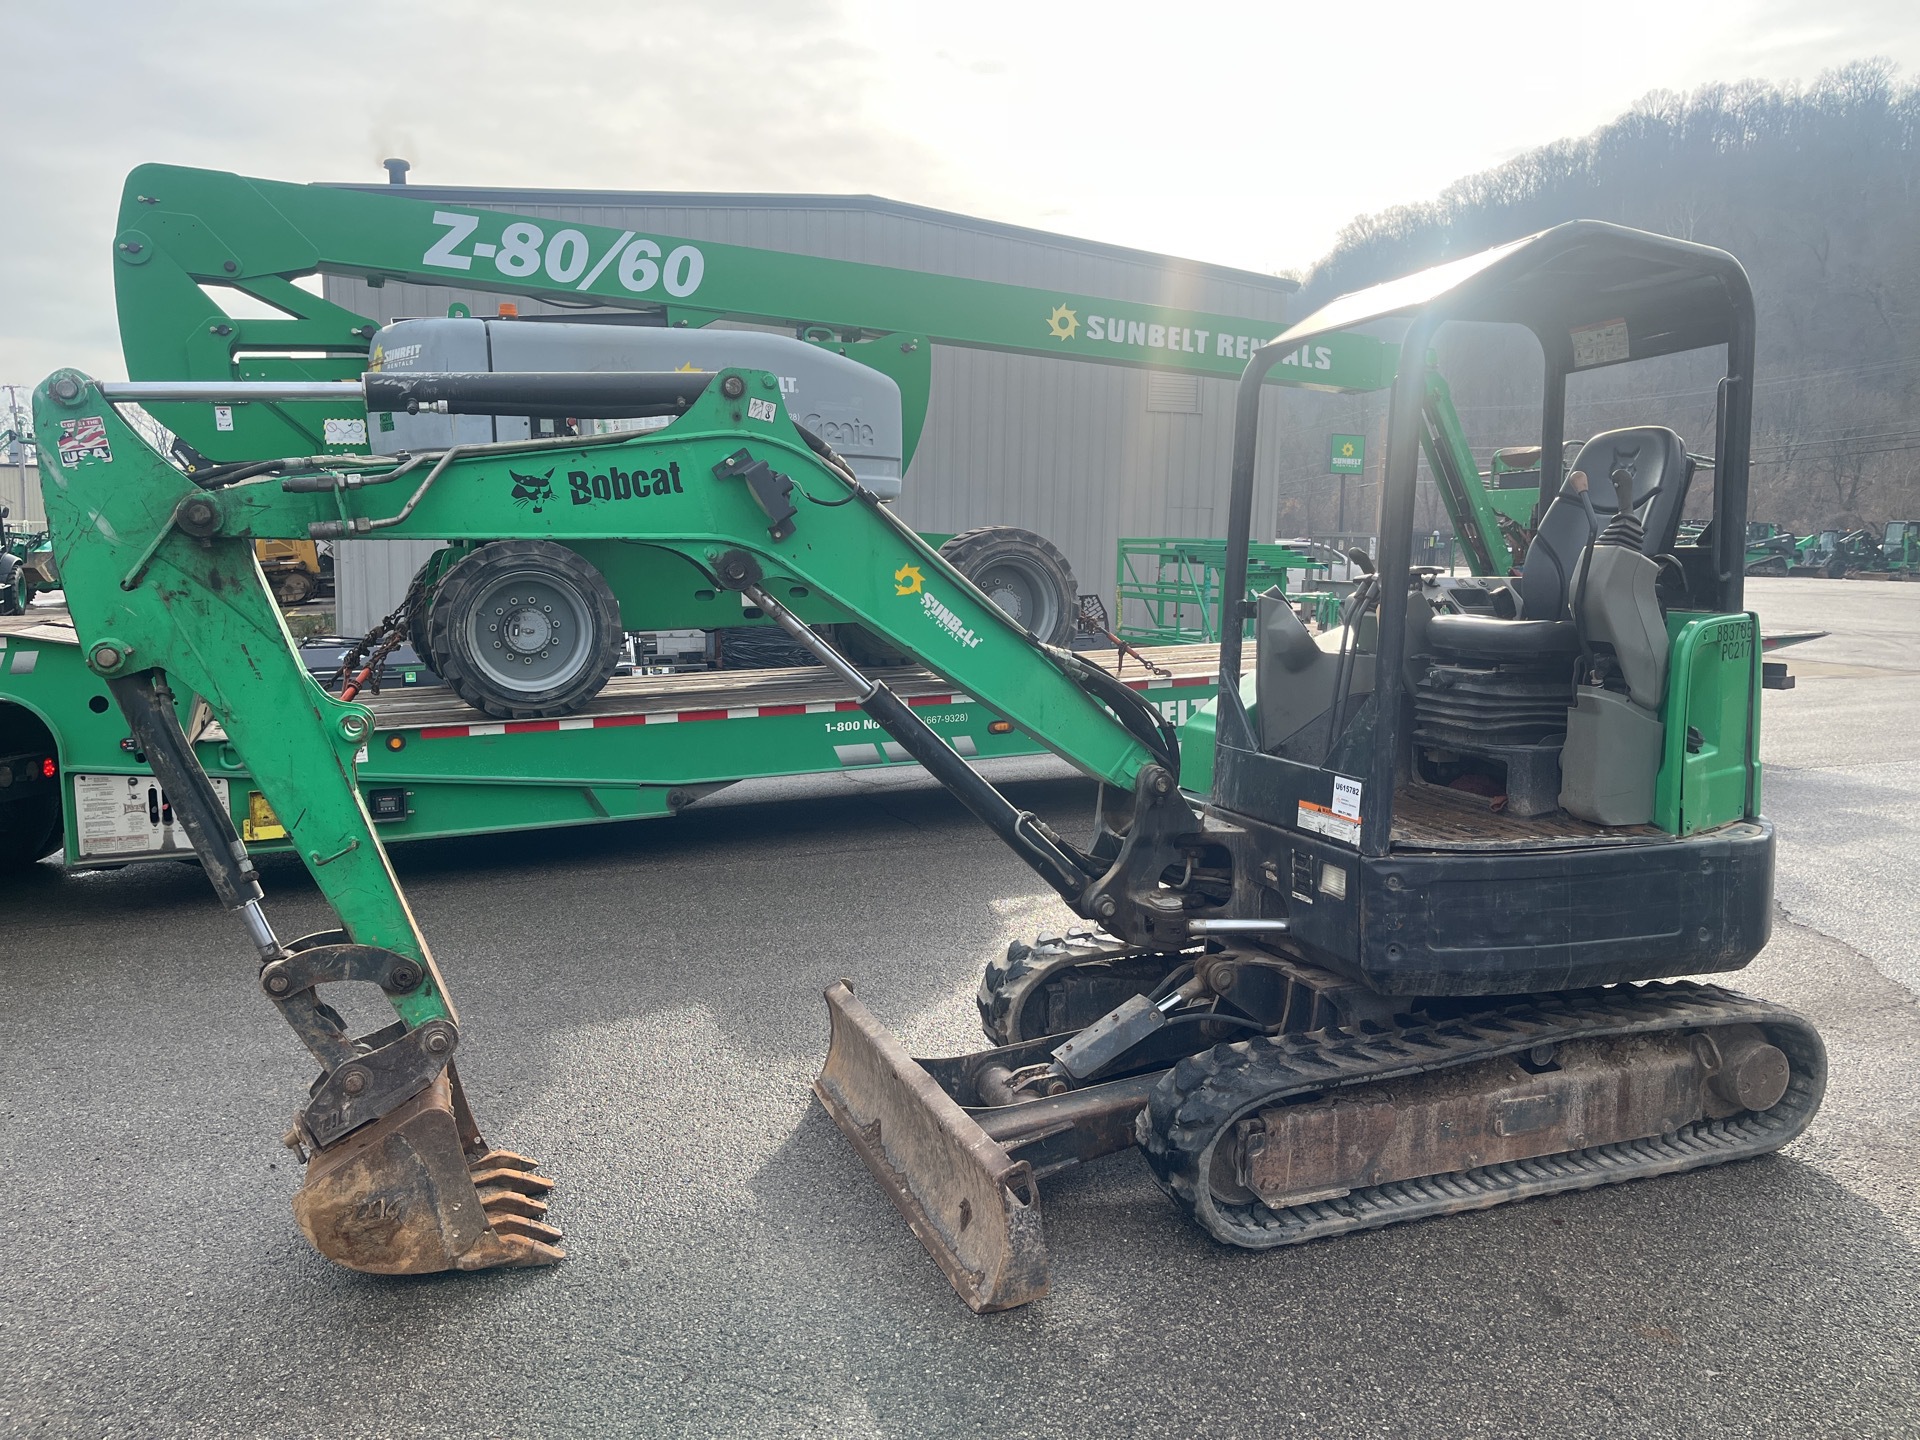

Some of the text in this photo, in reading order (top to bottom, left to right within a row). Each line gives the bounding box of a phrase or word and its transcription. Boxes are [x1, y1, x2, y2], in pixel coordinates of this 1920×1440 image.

[422, 210, 705, 298] Z-80/60
[1086, 315, 1332, 370] SUNBELT RENALS
[802, 413, 874, 447] Genie
[567, 461, 684, 506] Bobcat
[1721, 641, 1752, 661] PC217
[825, 720, 861, 733] 1-800
[923, 712, 969, 725] (667-9328)
[1335, 783, 1360, 796] U615782
